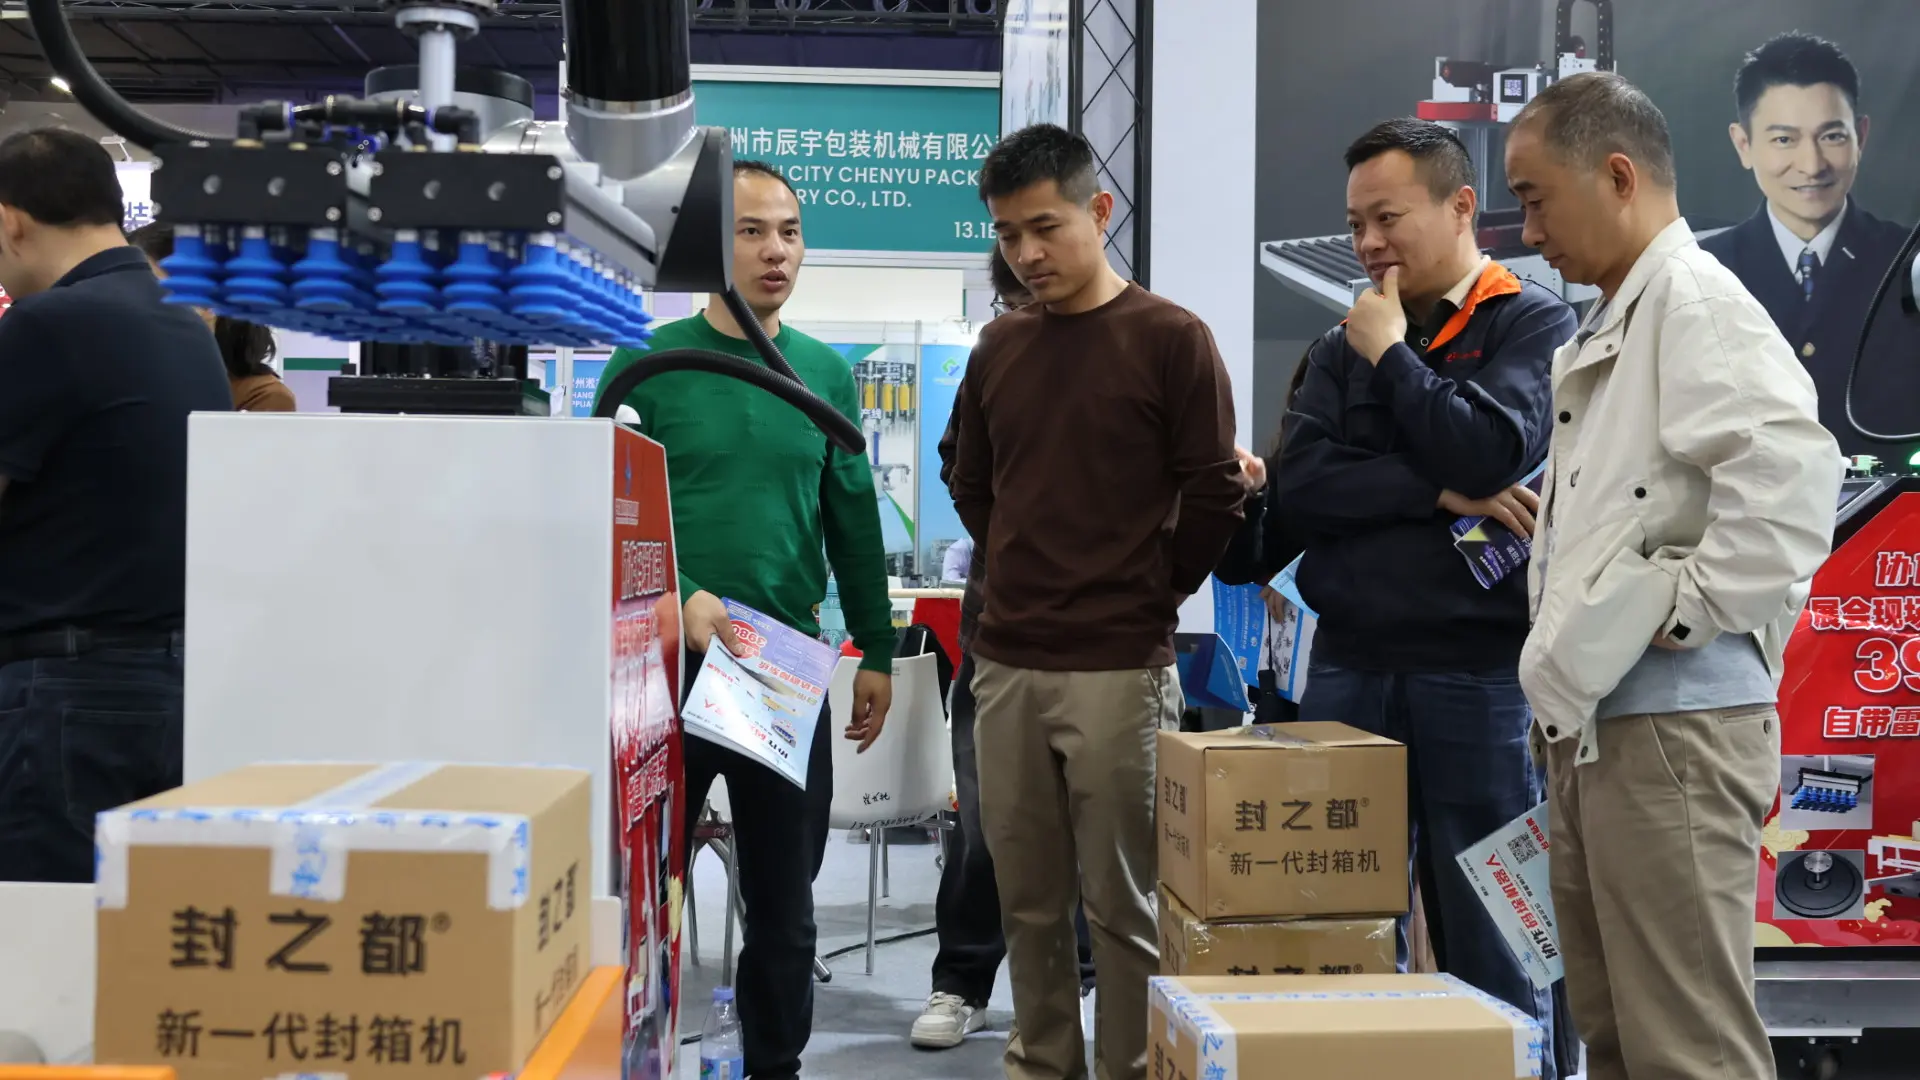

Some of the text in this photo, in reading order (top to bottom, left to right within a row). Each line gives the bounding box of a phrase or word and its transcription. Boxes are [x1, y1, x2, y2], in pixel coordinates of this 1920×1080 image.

[730, 127, 1000, 161] 州市辰宇包装机械有限公
[788, 165, 834, 182] CITY
[838, 166, 920, 185] CHENYU
[824, 189, 867, 209] CO.,
[871, 190, 912, 208] LTD.
[1875, 552, 1920, 587] 协
[1229, 850, 1381, 876] 新一代封箱机
[156, 1008, 467, 1065] 新一代封箱机
